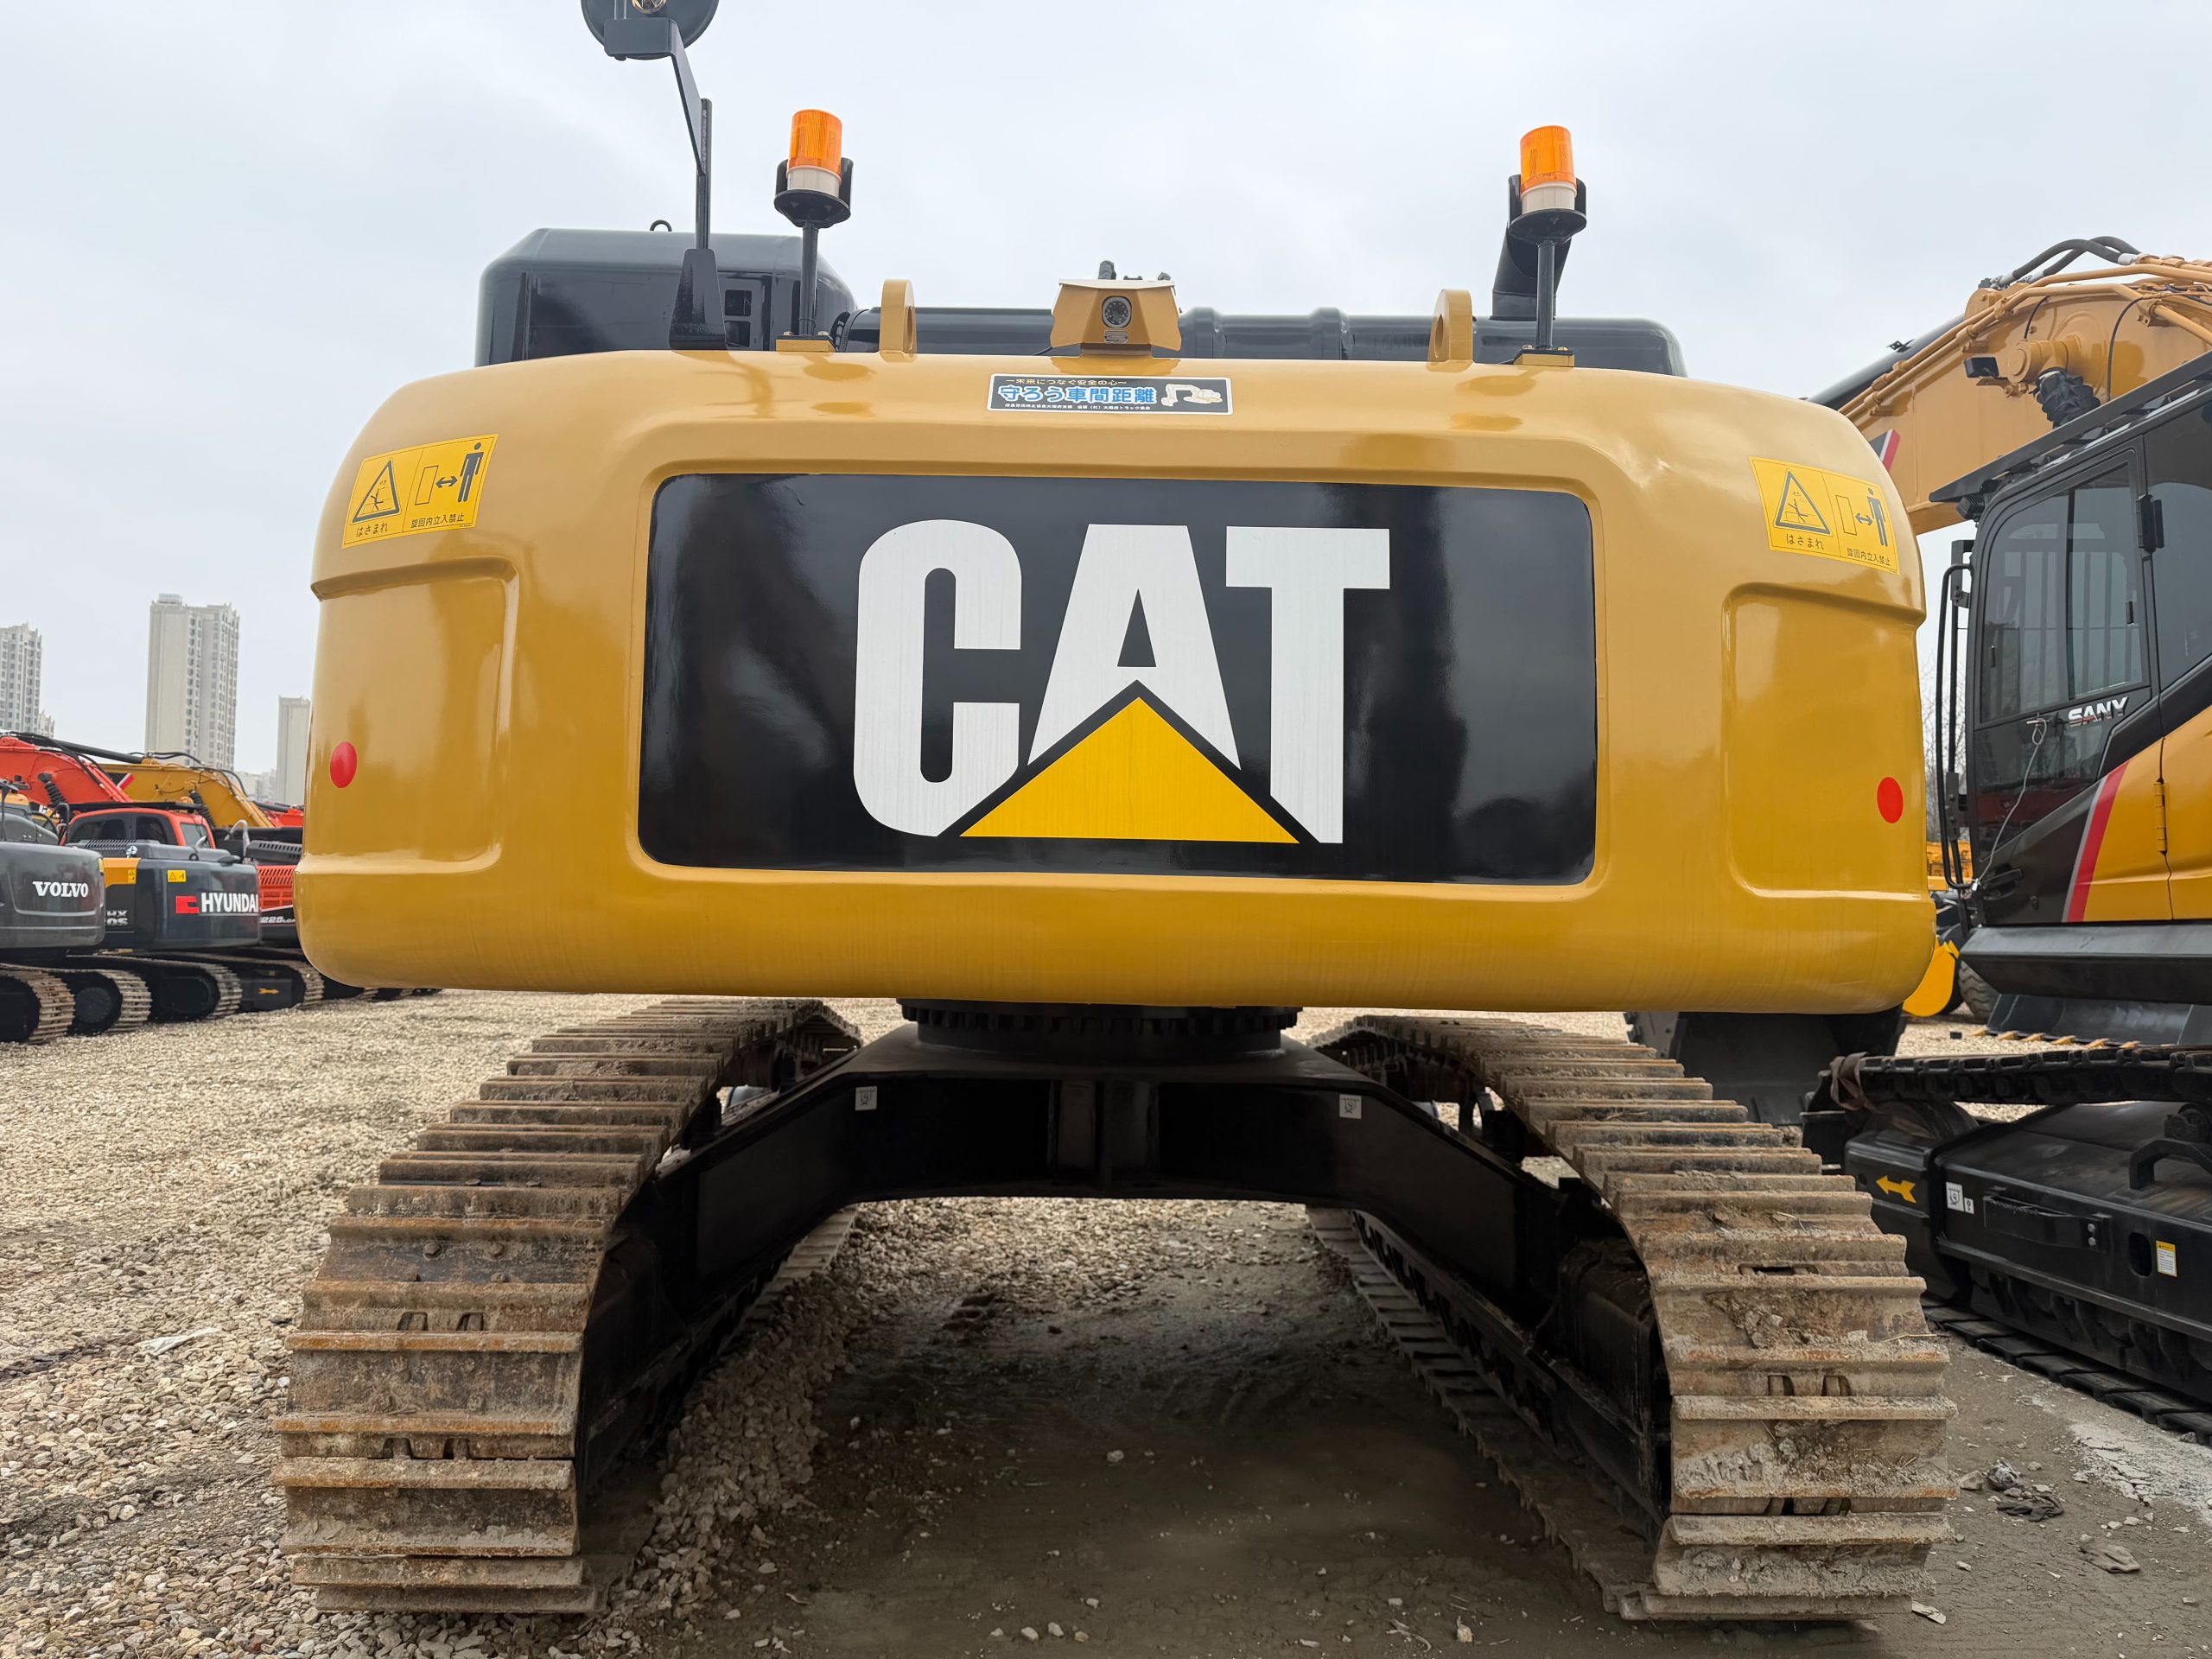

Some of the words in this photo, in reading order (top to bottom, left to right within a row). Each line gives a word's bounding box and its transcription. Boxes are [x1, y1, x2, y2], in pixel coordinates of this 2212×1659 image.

[998, 385, 1157, 404] 守ろう車間距離
[356, 522, 388, 537] はさまれ
[410, 513, 464, 528] 旋回内立入禁止
[1786, 533, 1825, 550] はさまれ
[1847, 547, 1891, 566] 旋回内立入禁止
[853, 518, 1389, 844] CAT
[2068, 696, 2127, 728] SANY
[32, 880, 89, 898] VOLVO
[201, 892, 259, 914] HYUNDAI
